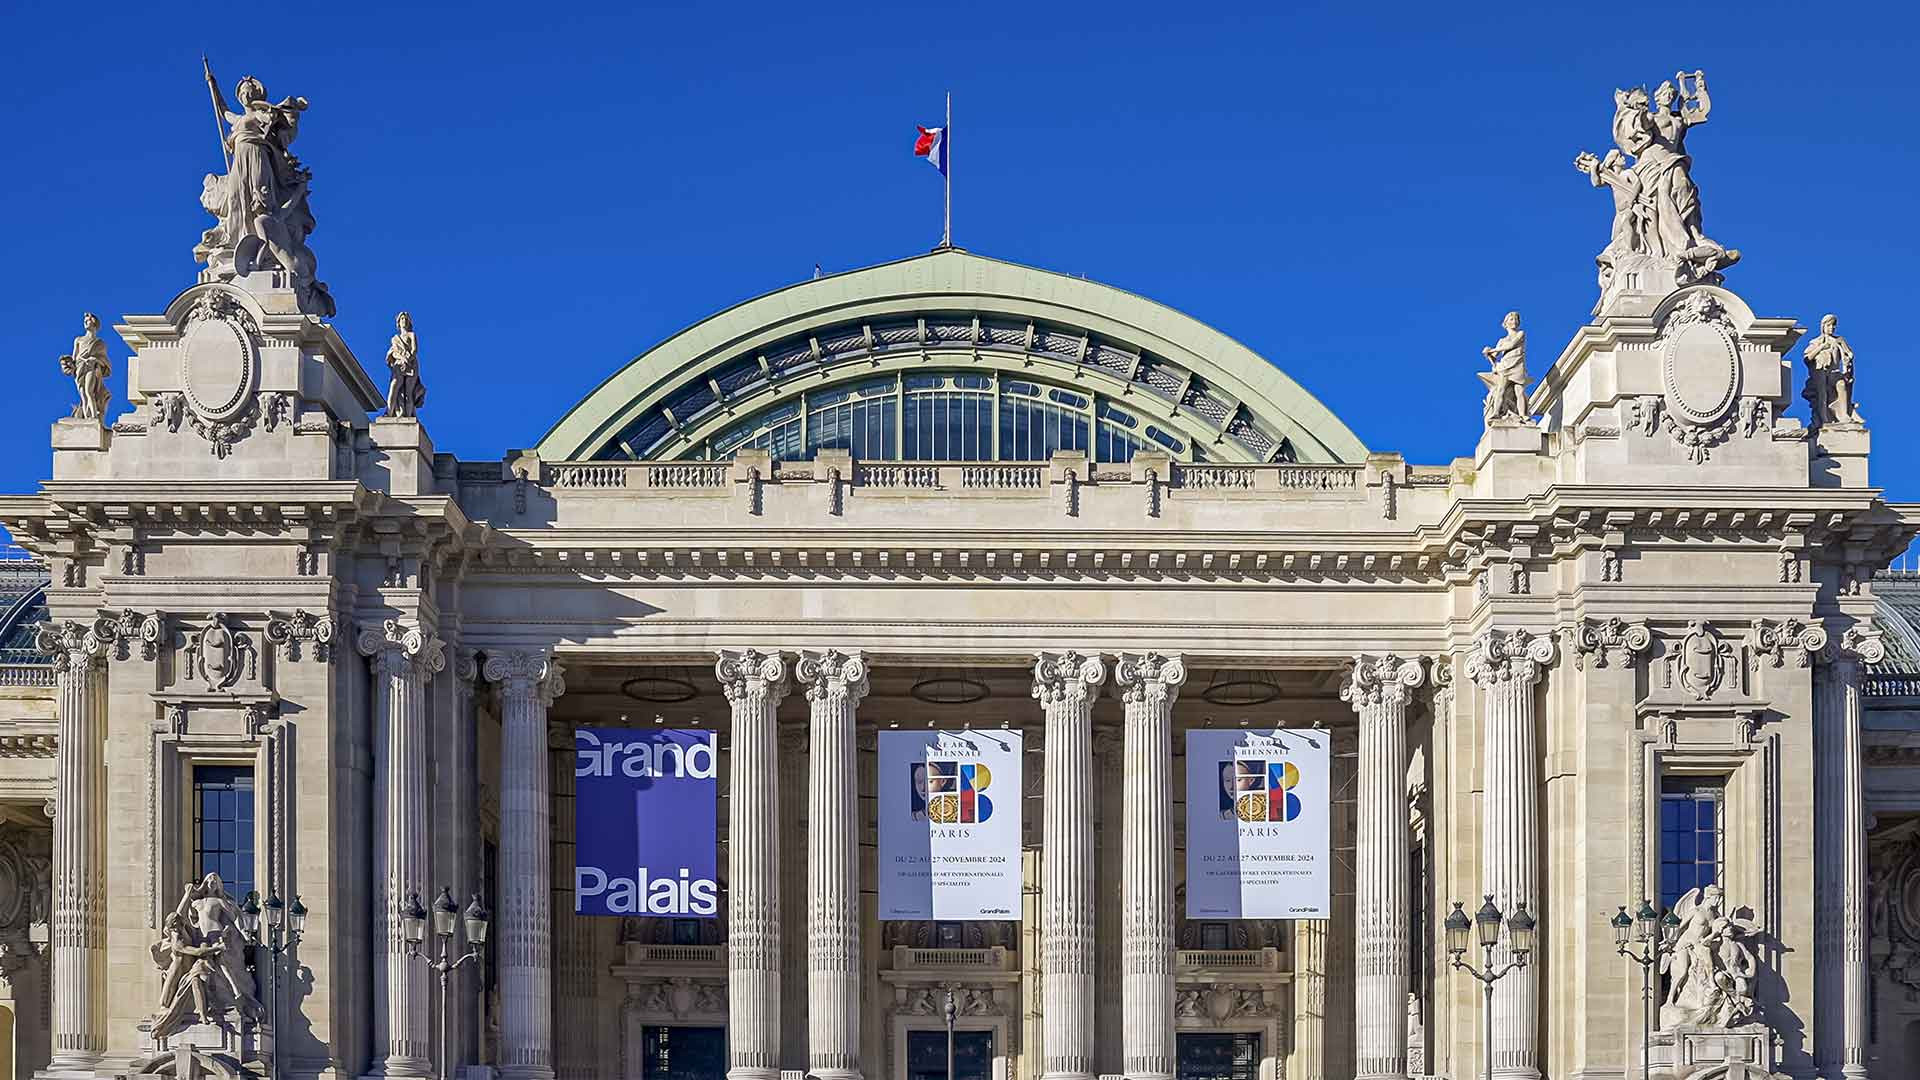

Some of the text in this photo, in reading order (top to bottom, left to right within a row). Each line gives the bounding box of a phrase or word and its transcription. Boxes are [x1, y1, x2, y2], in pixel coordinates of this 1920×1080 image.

[576, 730, 717, 779] Grand
[930, 829, 970, 838] PARIS
[1239, 828, 1279, 837] PARIS
[576, 866, 717, 915] Palais
